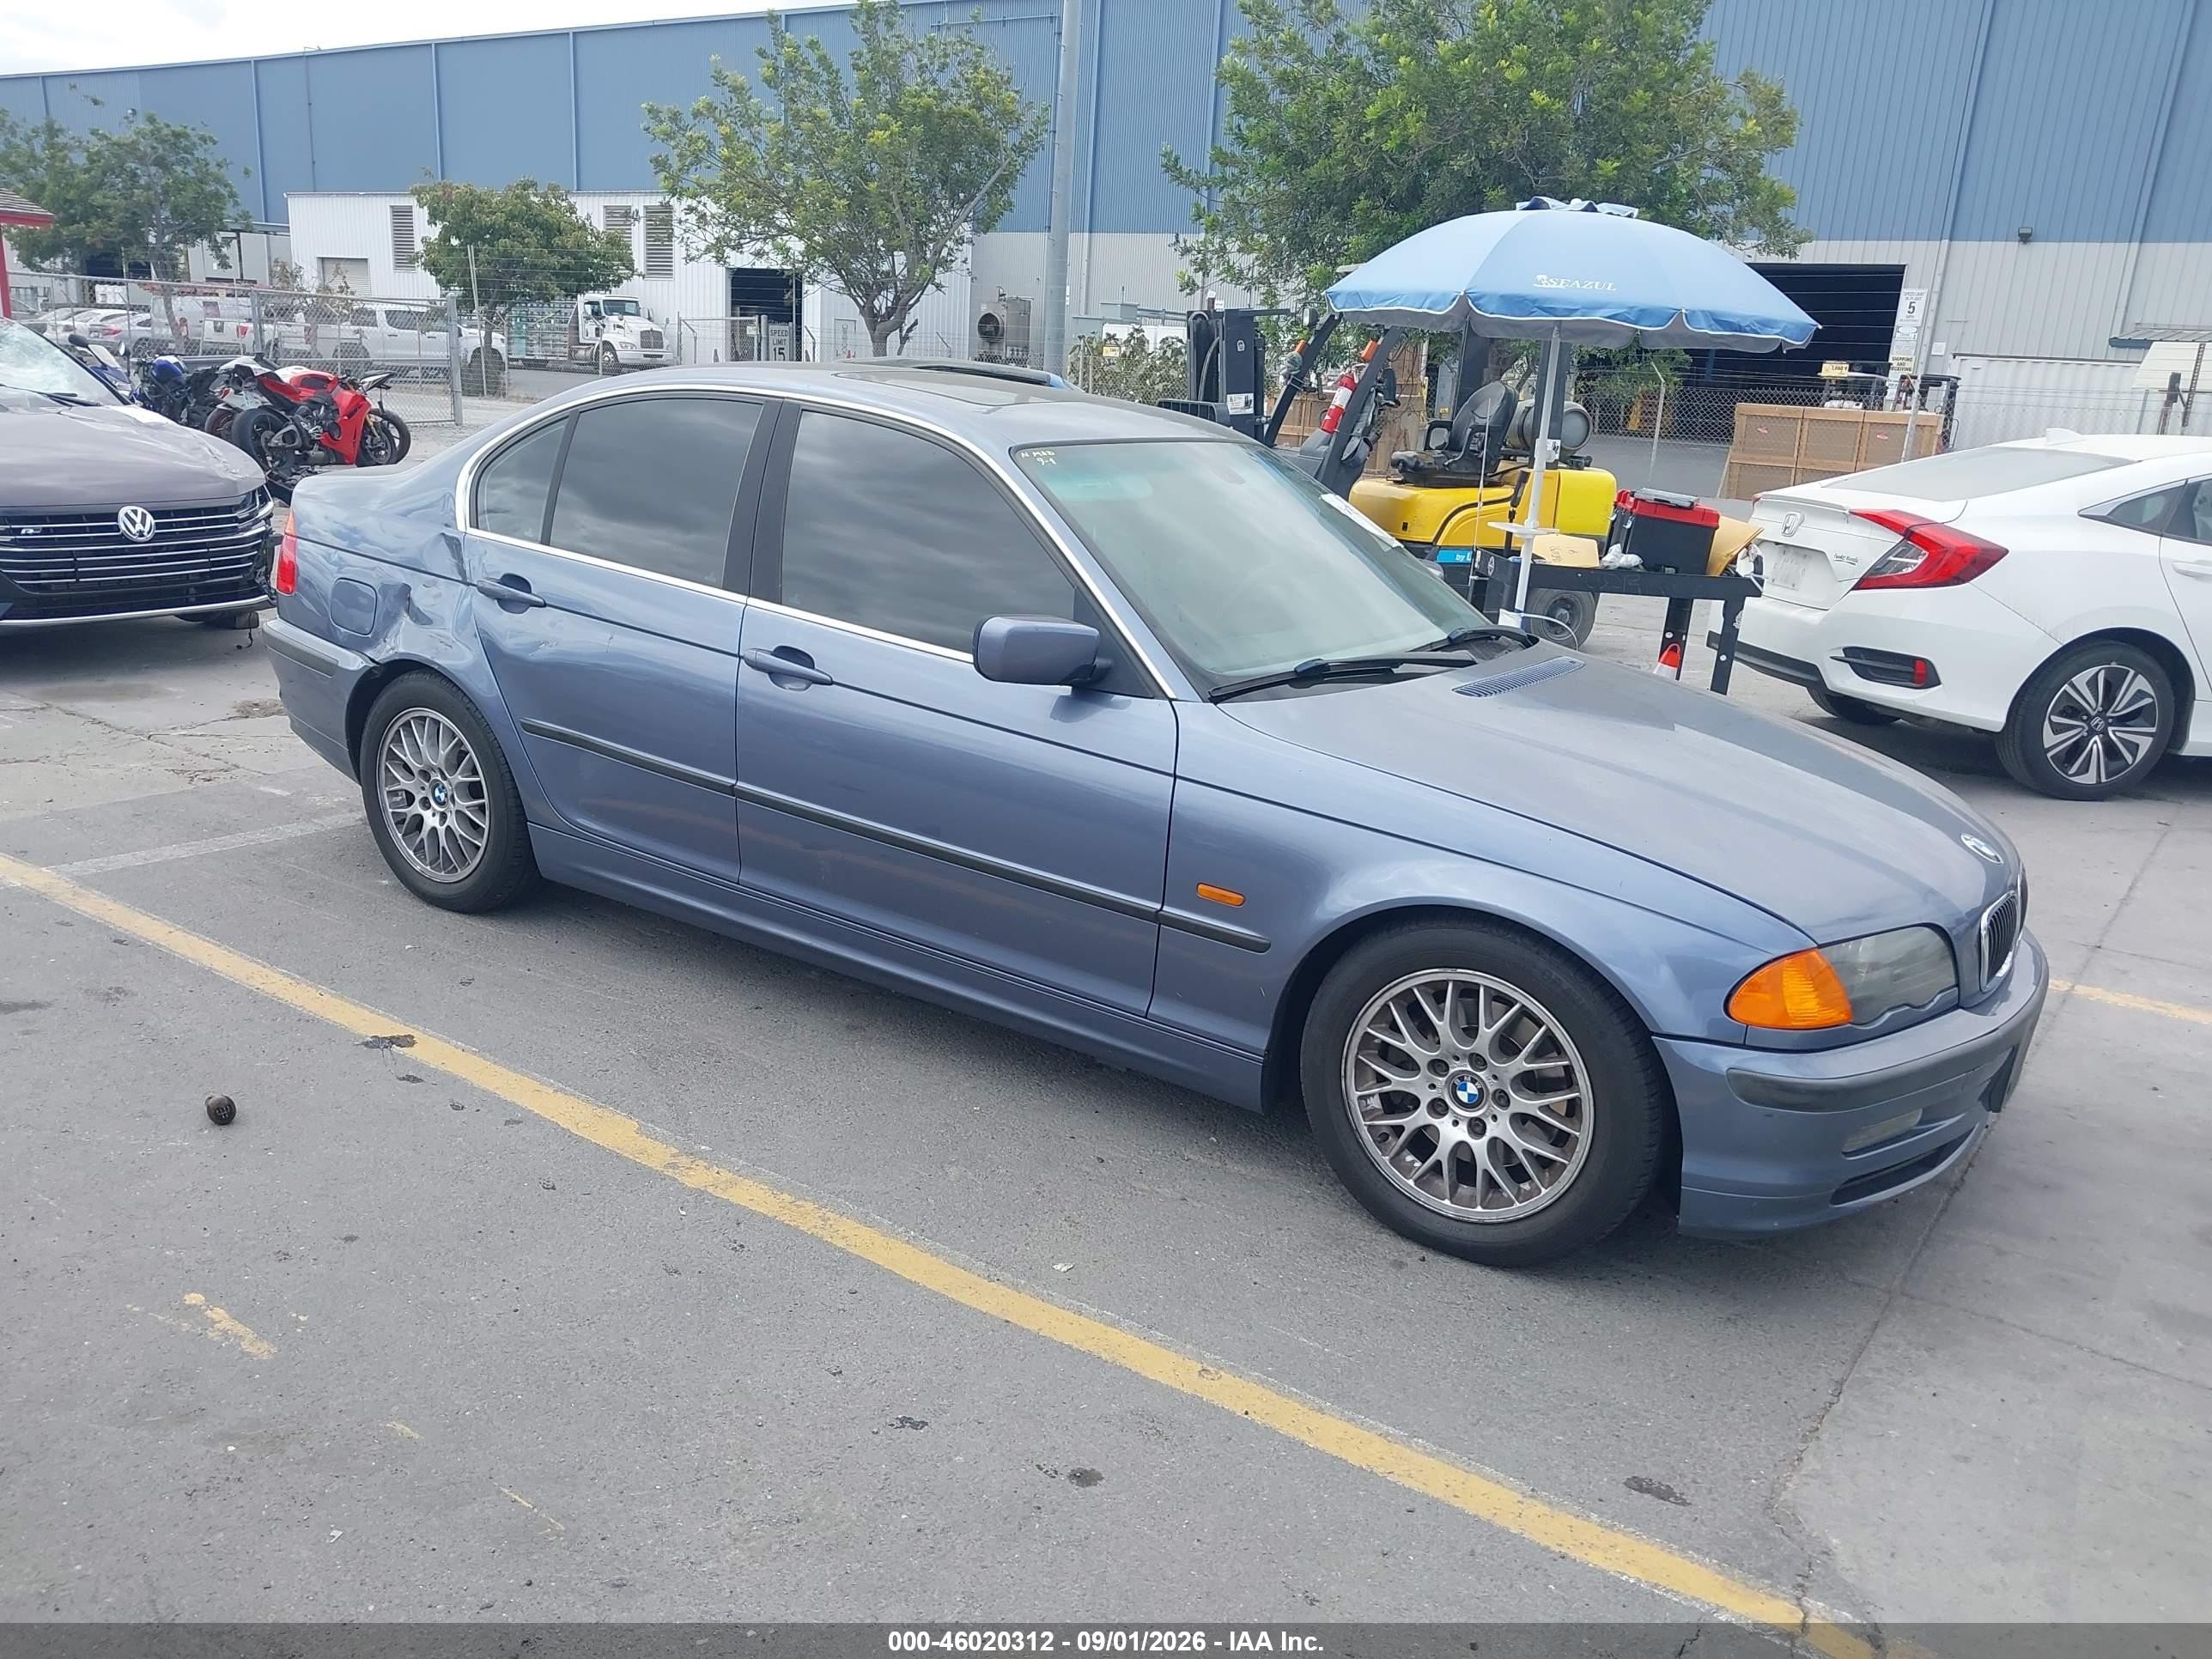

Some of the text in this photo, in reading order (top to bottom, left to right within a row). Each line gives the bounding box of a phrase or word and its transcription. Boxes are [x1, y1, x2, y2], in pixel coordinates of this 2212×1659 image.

[1548, 277, 1616, 291] SEAZUL
[1907, 301, 1916, 314] 5
[773, 347, 786, 361] 15
